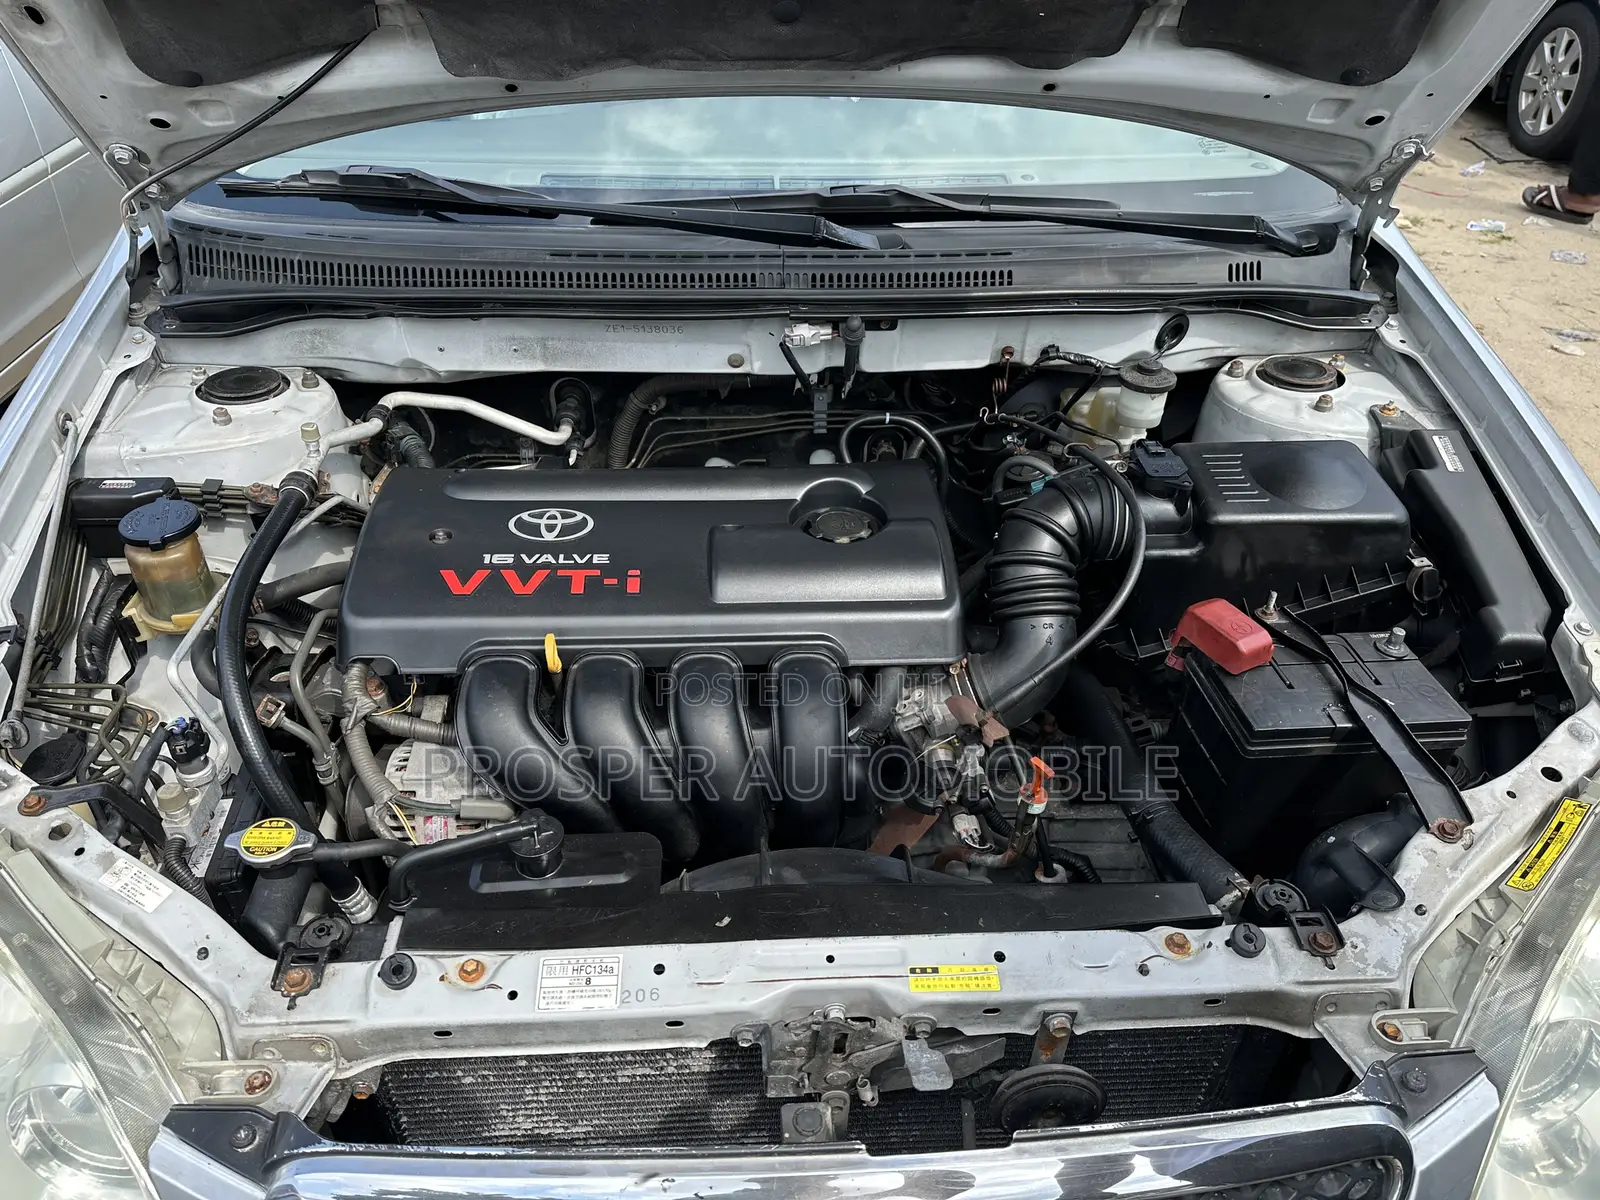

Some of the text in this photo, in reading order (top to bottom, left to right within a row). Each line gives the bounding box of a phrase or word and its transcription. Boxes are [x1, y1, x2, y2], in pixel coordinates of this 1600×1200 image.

[604, 324, 684, 334] ZE1-5138036
[482, 553, 611, 564] 16 VALVE
[439, 569, 641, 595] VVT-i
[571, 964, 615, 976] HFC134a
[584, 977, 592, 986] 8
[621, 987, 661, 1004] 206
